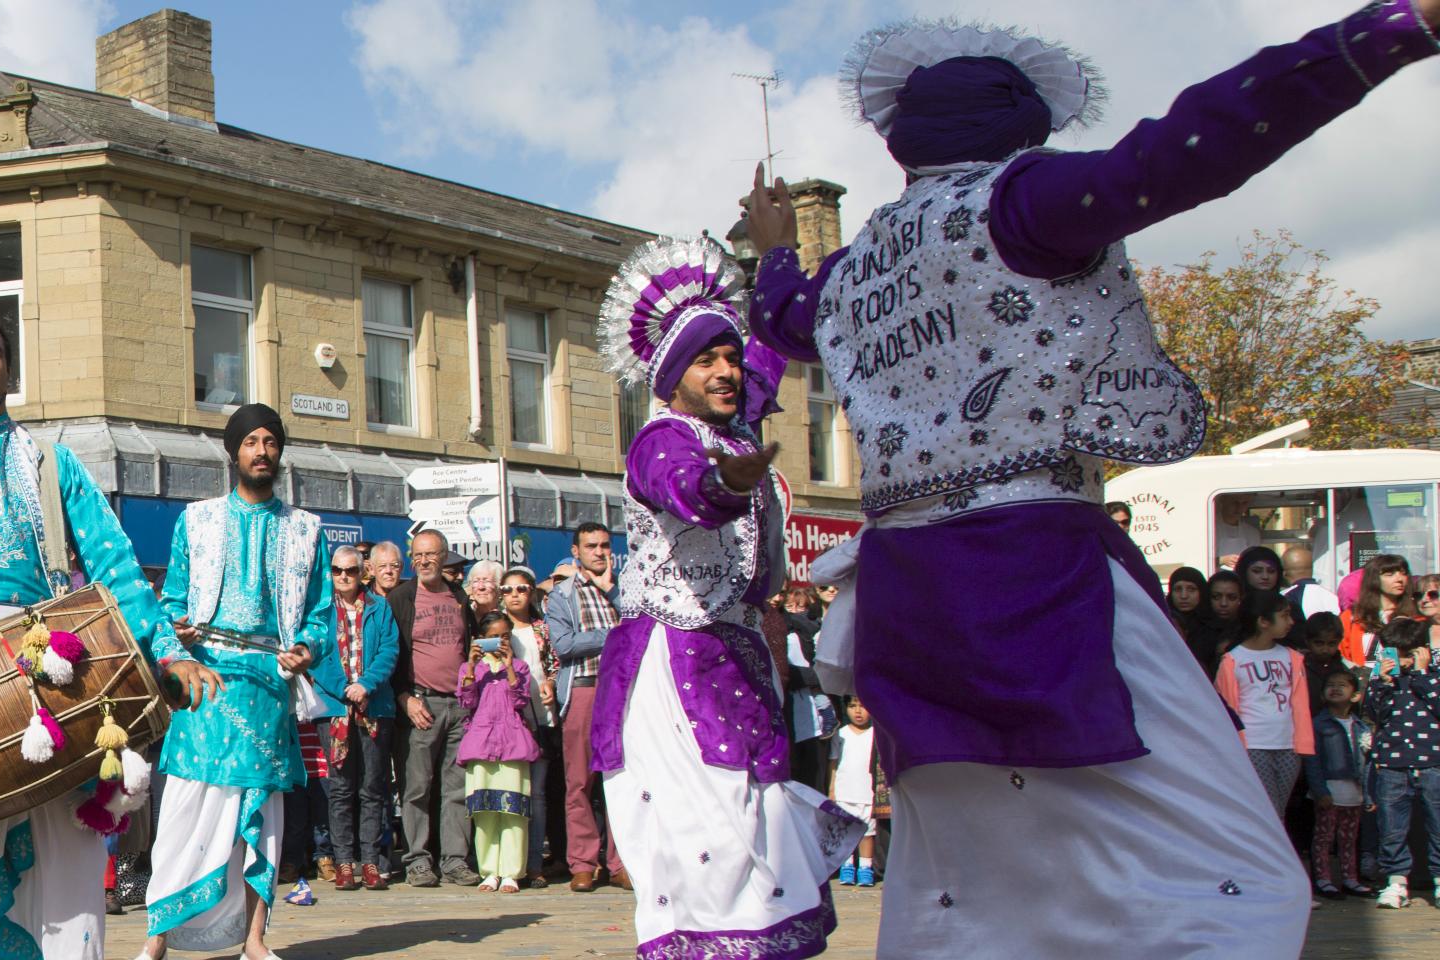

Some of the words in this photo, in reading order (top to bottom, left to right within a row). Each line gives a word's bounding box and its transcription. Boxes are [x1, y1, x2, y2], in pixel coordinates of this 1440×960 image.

[840, 213, 924, 286] PUNJABI
[851, 264, 922, 335] ROOTS
[846, 302, 956, 382] ACADEMY
[293, 398, 333, 412] SCOTLAND
[336, 403, 347, 414] RD
[1134, 523, 1159, 532] 1945
[661, 565, 722, 581] PUNJAB
